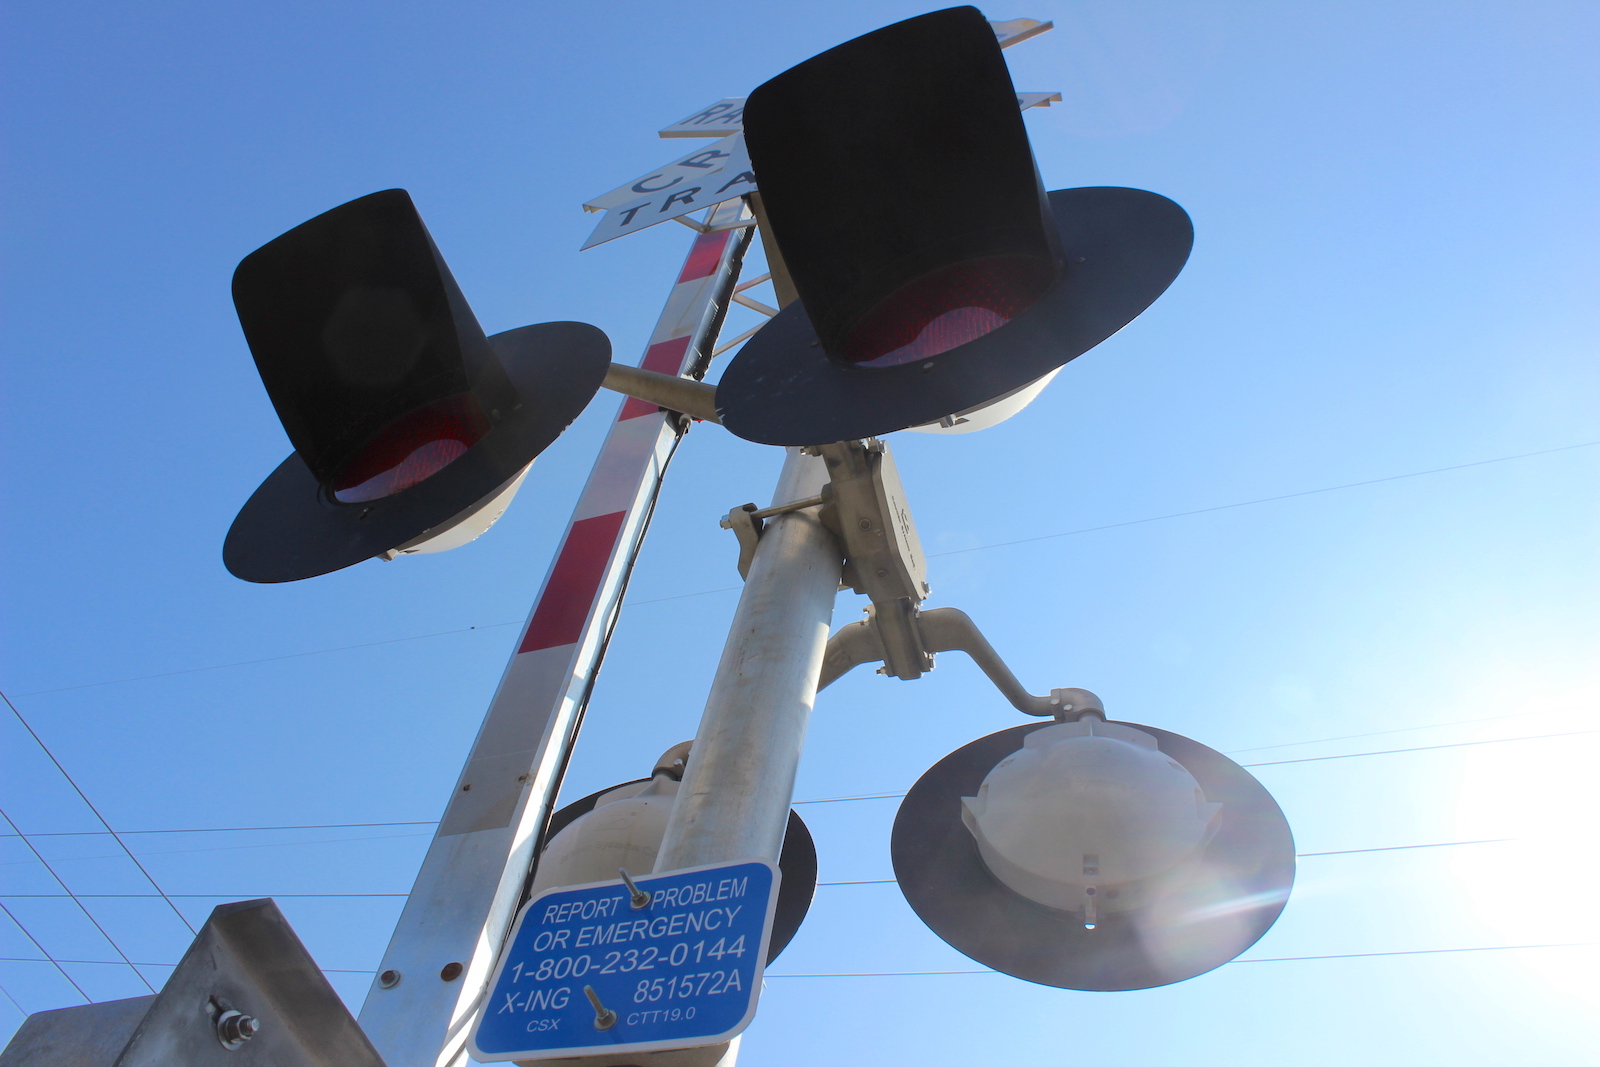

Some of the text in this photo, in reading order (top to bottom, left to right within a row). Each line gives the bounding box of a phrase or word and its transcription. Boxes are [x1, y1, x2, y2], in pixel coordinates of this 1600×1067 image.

[680, 103, 743, 125] RA
[631, 150, 730, 193] CR
[619, 171, 757, 227] TRA
[542, 876, 748, 925] REPORT PROBLEM
[533, 905, 743, 953] OR EMERGENCY
[511, 935, 747, 984] 1-800-232-0144
[498, 968, 742, 1015] X-ING 851572A
[526, 1006, 697, 1033] CSX CTT19.0
